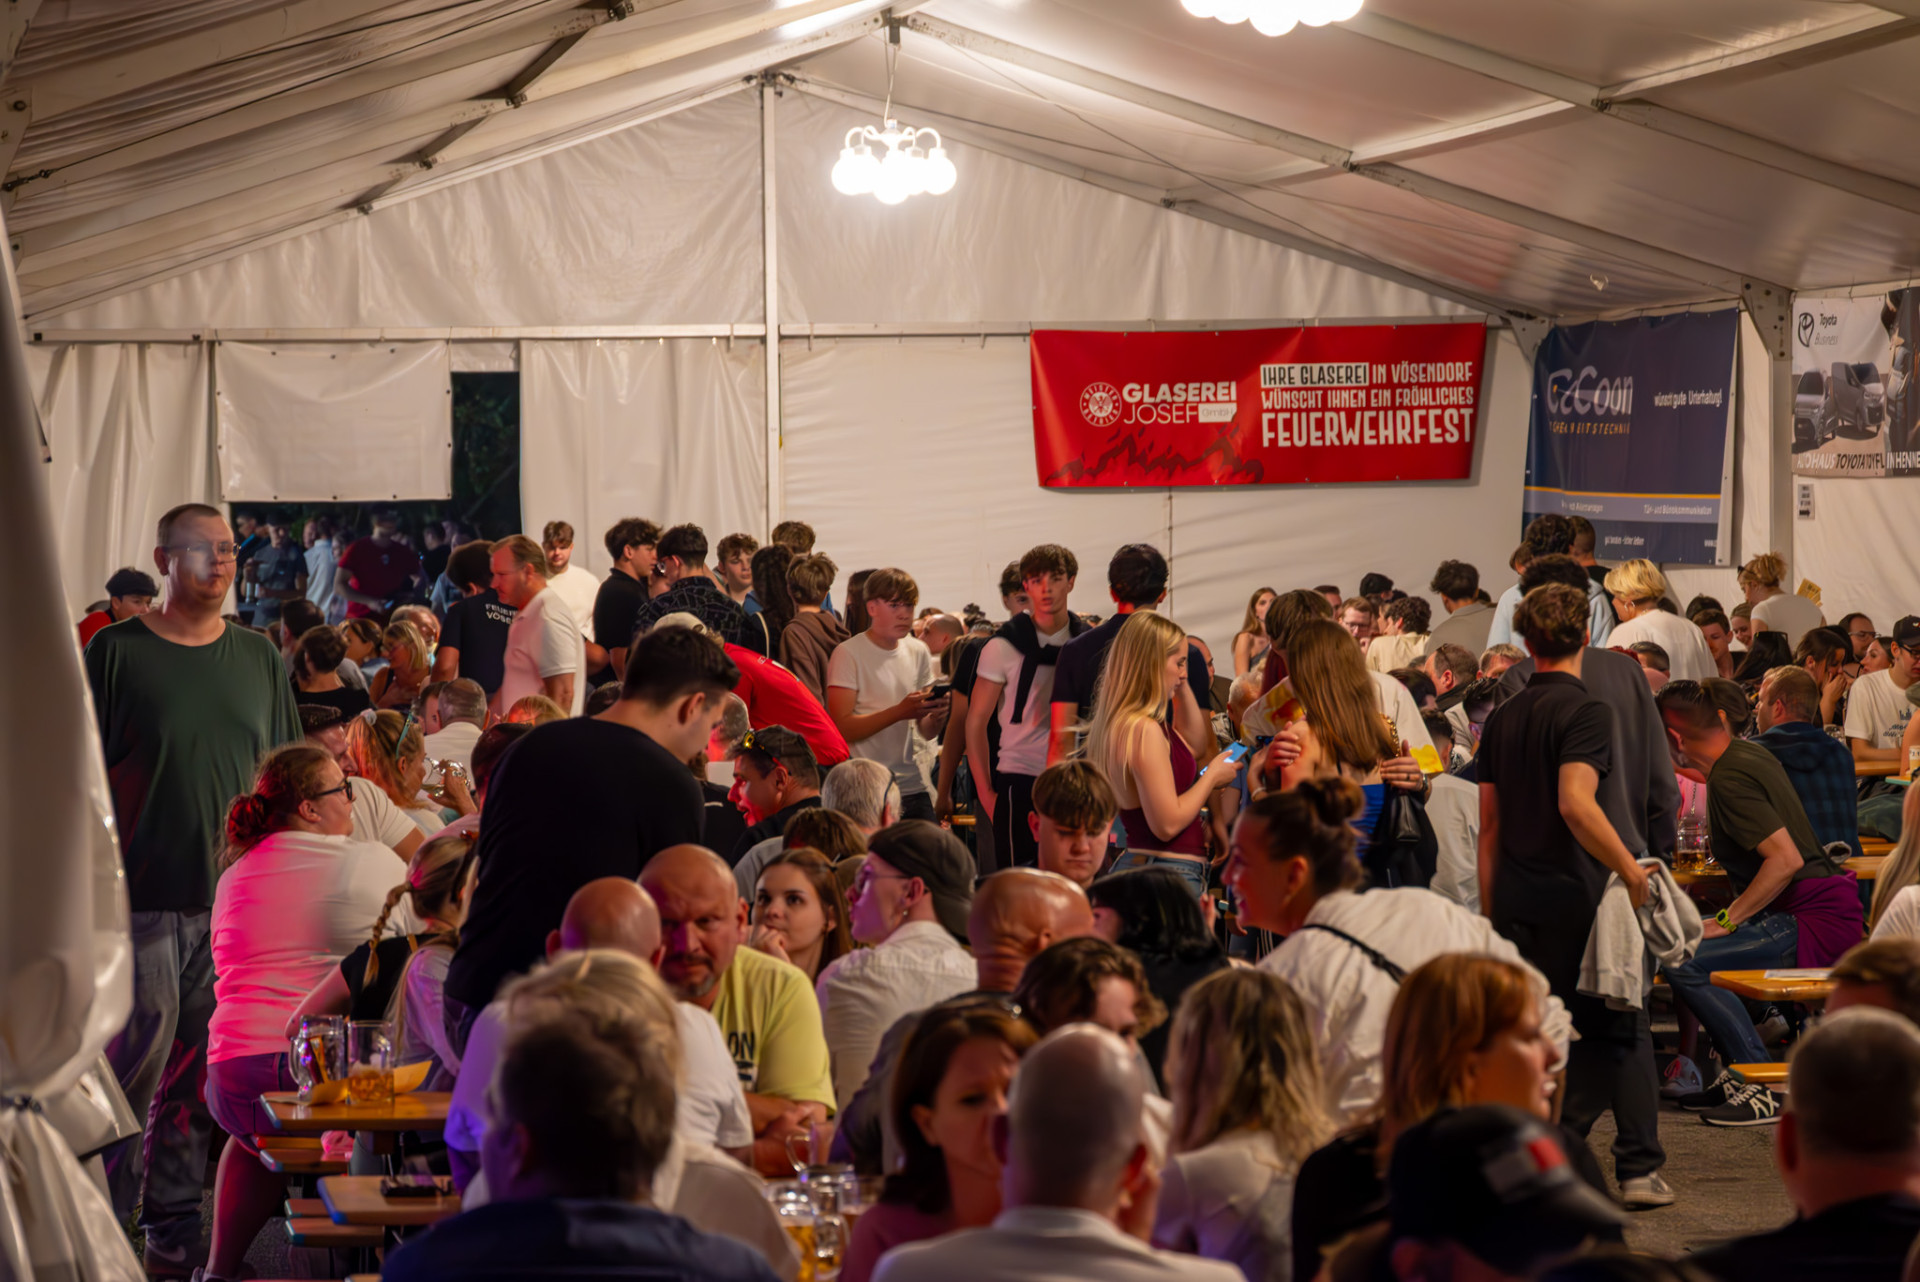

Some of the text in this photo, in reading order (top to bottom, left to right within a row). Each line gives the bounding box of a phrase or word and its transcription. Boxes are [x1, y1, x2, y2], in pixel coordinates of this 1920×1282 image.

[1819, 313, 1838, 329] Toyota
[1263, 360, 1473, 386] IHRE GLASEREI IN VÖSENDORF
[1122, 381, 1237, 403] GLASEREI
[1261, 385, 1474, 410] WÜNSCHT IHNEN EIN FRÖHLICHES
[1123, 402, 1198, 424] JOSEF
[1201, 407, 1234, 419] GmbH
[1262, 407, 1474, 448] FEUERWEHRFEST
[1835, 453, 1865, 470] TOYOTA
[1749, 1089, 1780, 1120] AX
